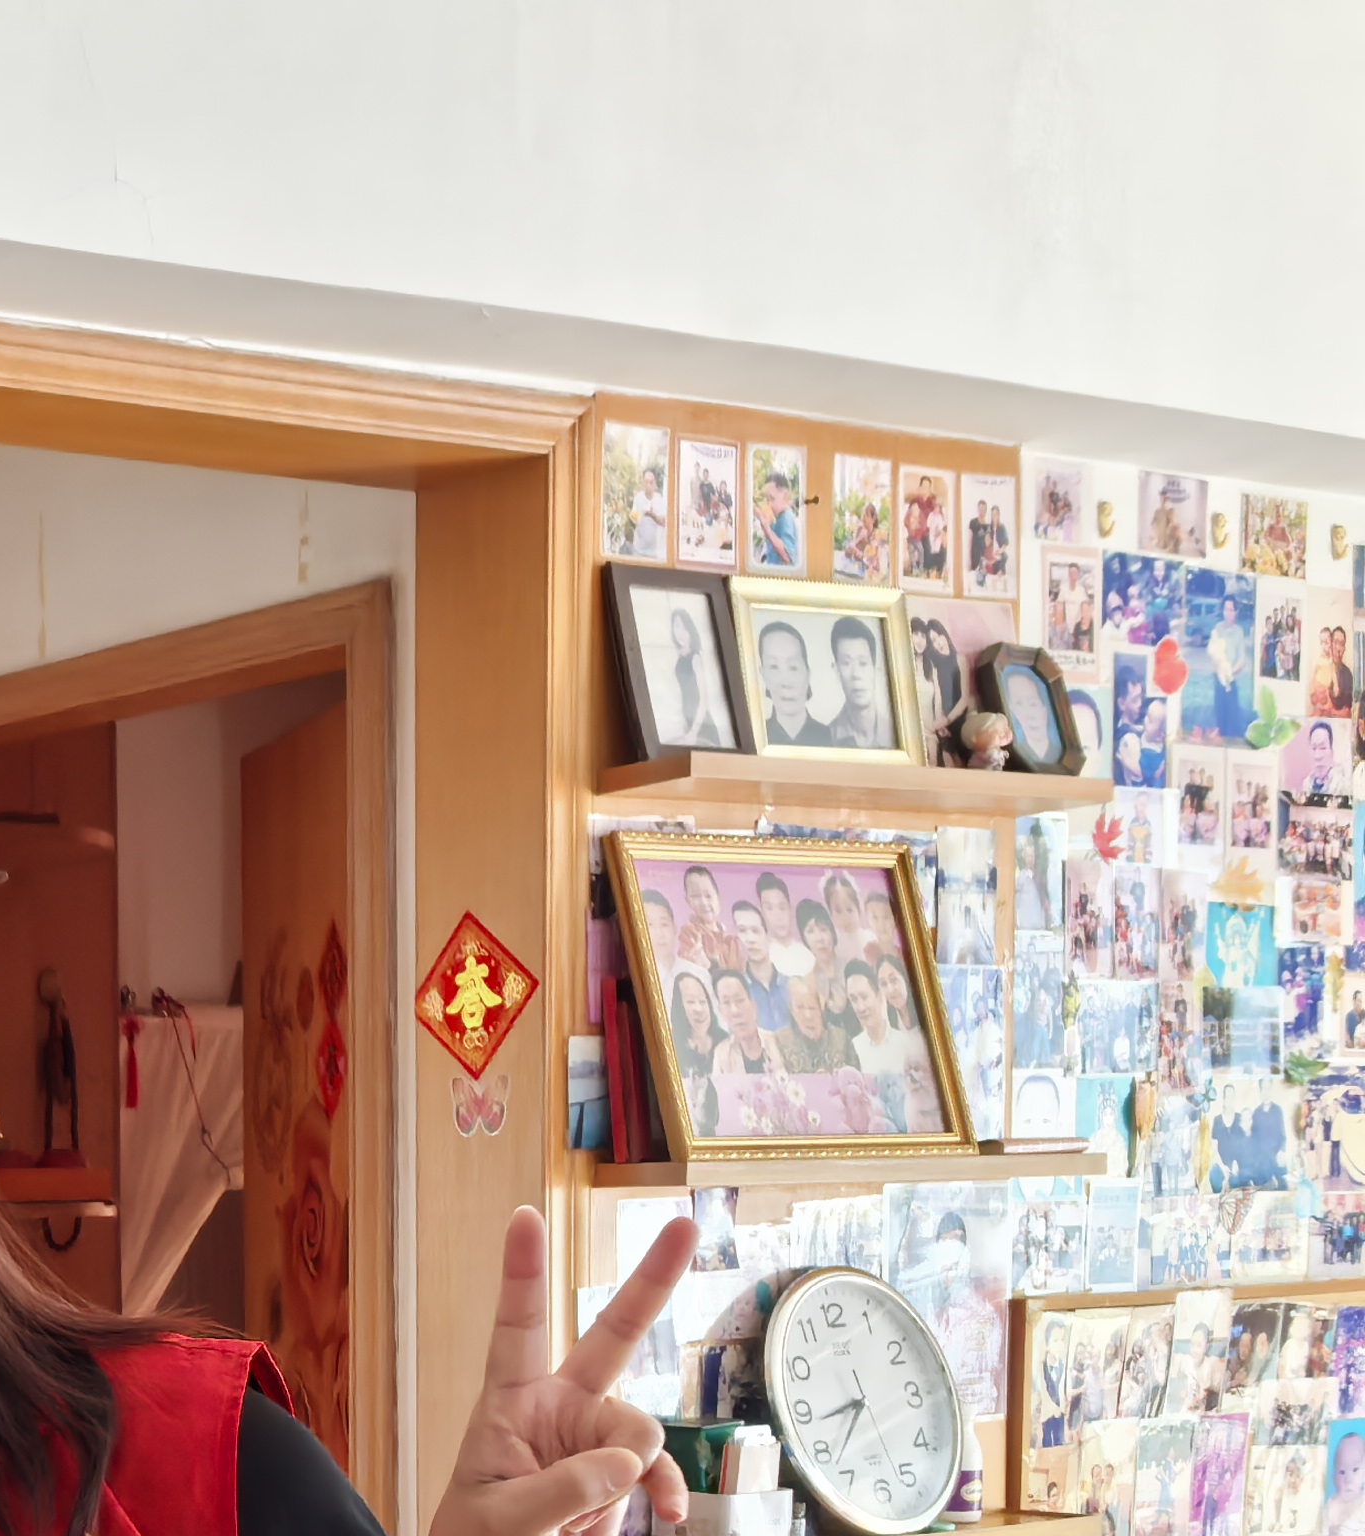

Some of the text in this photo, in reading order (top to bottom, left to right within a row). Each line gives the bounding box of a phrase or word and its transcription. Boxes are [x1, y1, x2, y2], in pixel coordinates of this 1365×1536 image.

[820, 1302, 847, 1328] 12
[862, 1310, 873, 1334] 1
[797, 1317, 817, 1344] 11
[887, 1340, 906, 1365] 2
[789, 1356, 811, 1382] 10
[904, 1381, 923, 1409] 3
[793, 1399, 812, 1425] 9
[813, 1440, 831, 1464] 8
[913, 1427, 930, 1452] 4
[839, 1469, 855, 1495] 7
[899, 1463, 917, 1488] 5
[874, 1479, 892, 1504] 6
